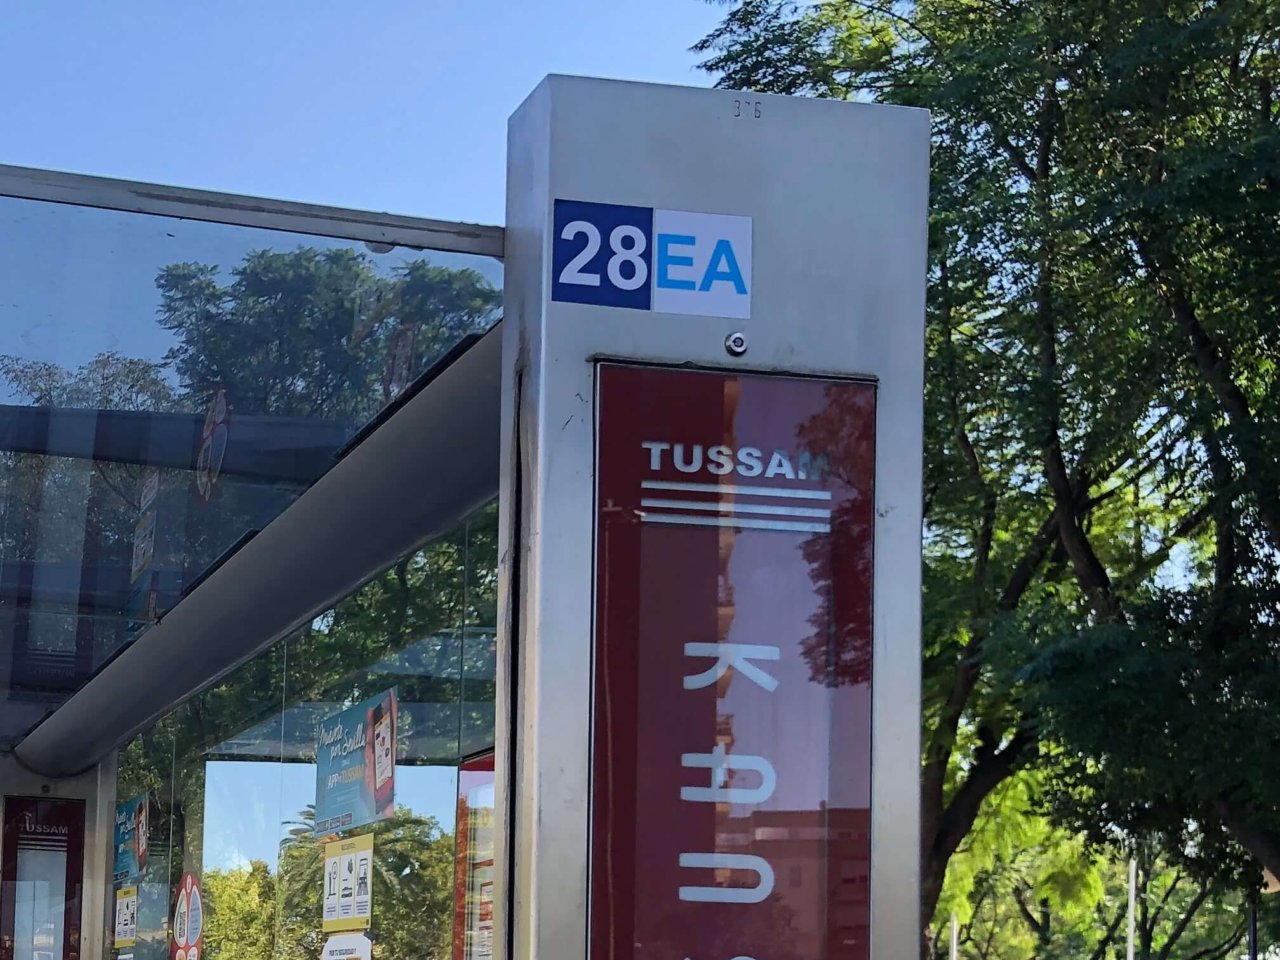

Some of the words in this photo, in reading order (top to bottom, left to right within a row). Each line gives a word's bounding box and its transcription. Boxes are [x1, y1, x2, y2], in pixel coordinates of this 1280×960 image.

[558, 219, 648, 291] 28
[656, 233, 749, 296] EA
[19, 824, 69, 834] TUSSAM
